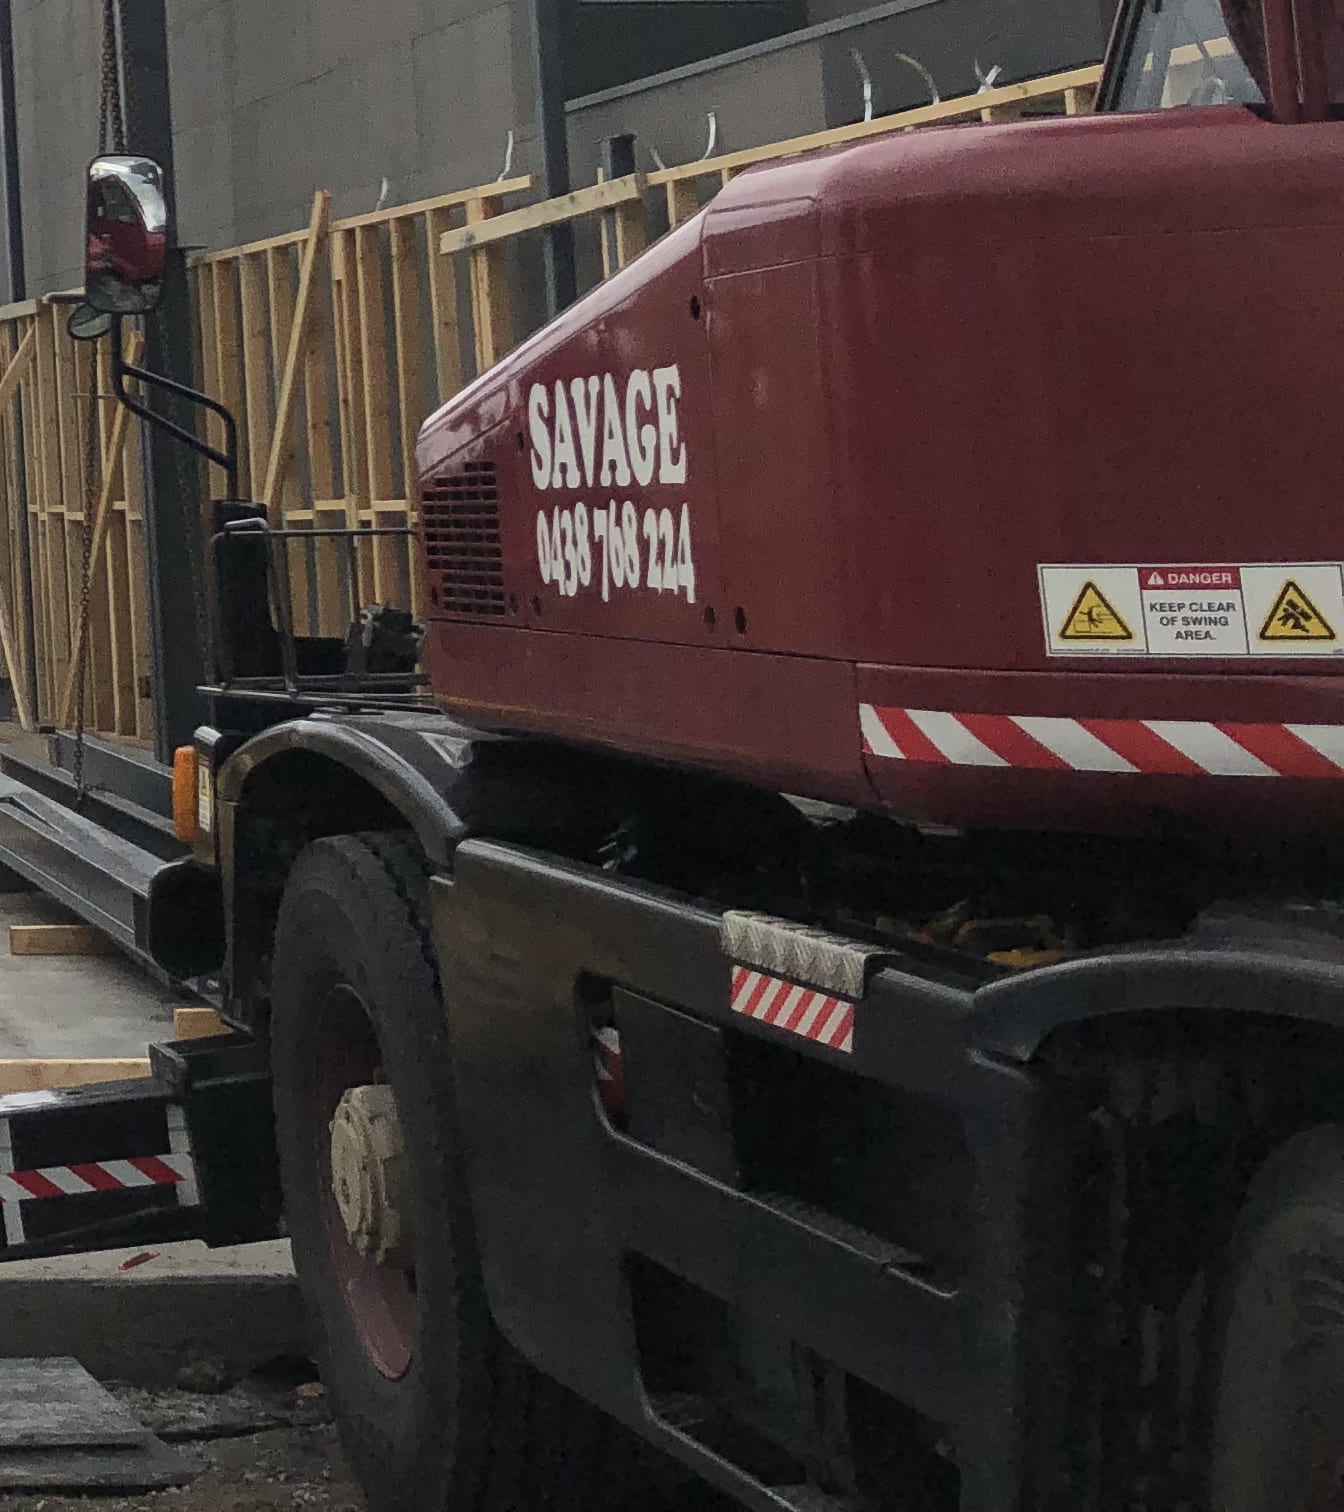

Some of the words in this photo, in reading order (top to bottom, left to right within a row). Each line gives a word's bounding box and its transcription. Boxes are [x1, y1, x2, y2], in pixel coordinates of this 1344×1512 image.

[528, 363, 687, 490] SAVAGE
[537, 501, 592, 598] 0438
[593, 498, 641, 603] 768
[643, 502, 696, 604] 224
[1167, 572, 1232, 585] DANGER
[1149, 601, 1186, 613] KEEP
[1188, 601, 1237, 613] CLEAR
[1159, 615, 1179, 626] OF
[1181, 615, 1230, 626] SWING
